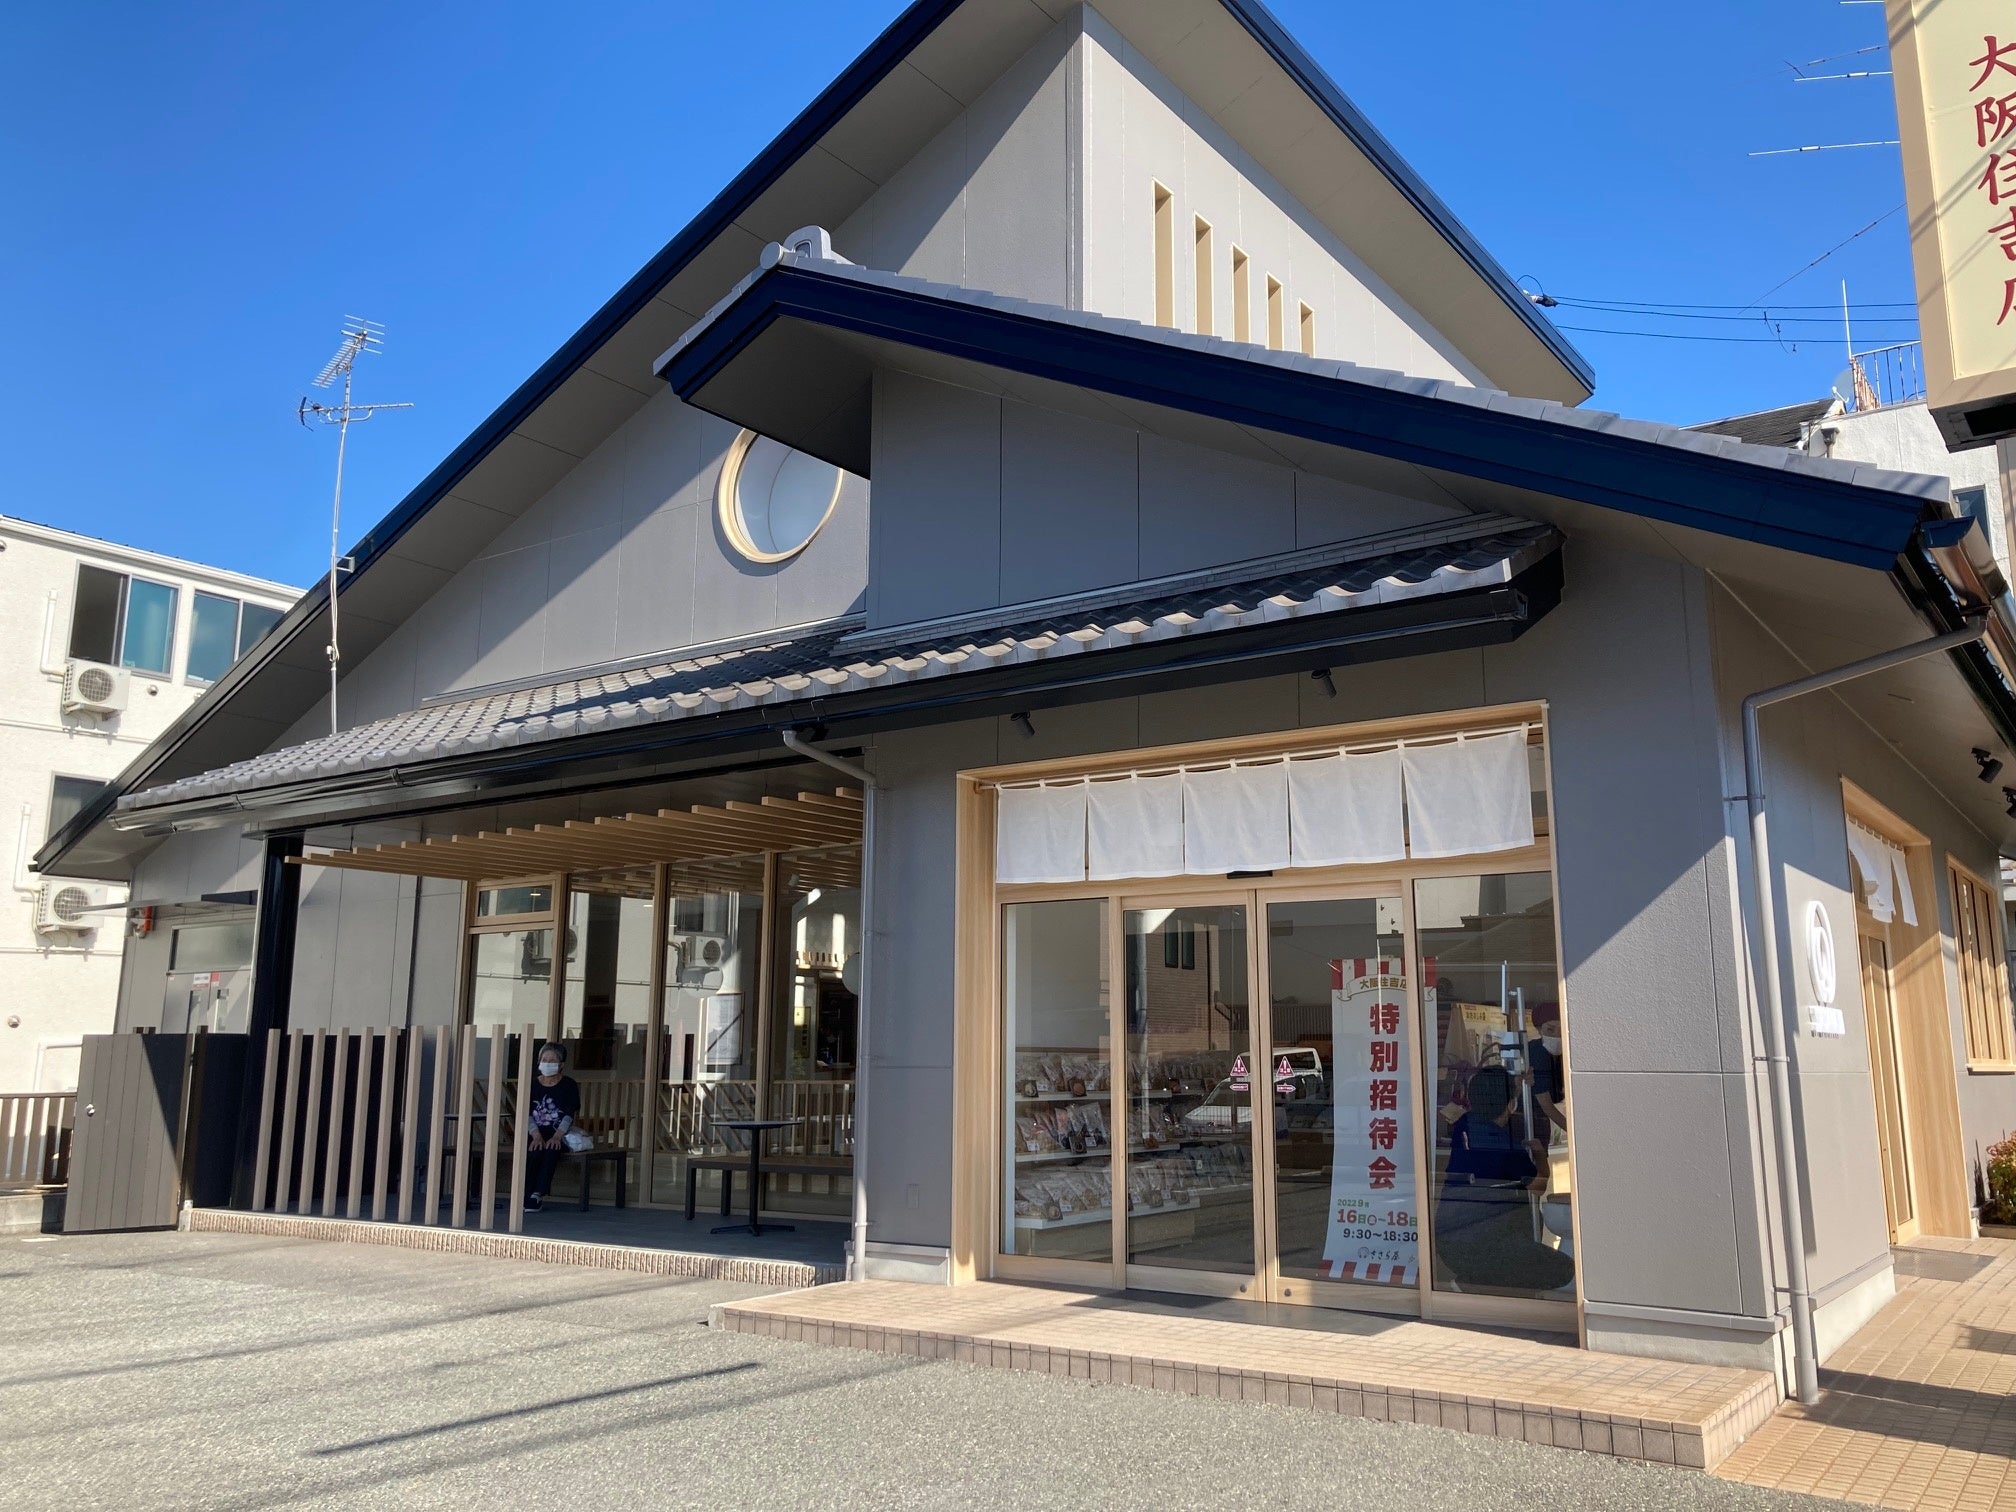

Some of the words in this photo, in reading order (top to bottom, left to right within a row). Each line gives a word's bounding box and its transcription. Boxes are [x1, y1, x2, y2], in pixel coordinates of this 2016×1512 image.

[1368, 1003, 1399, 1190] 特別招待会
